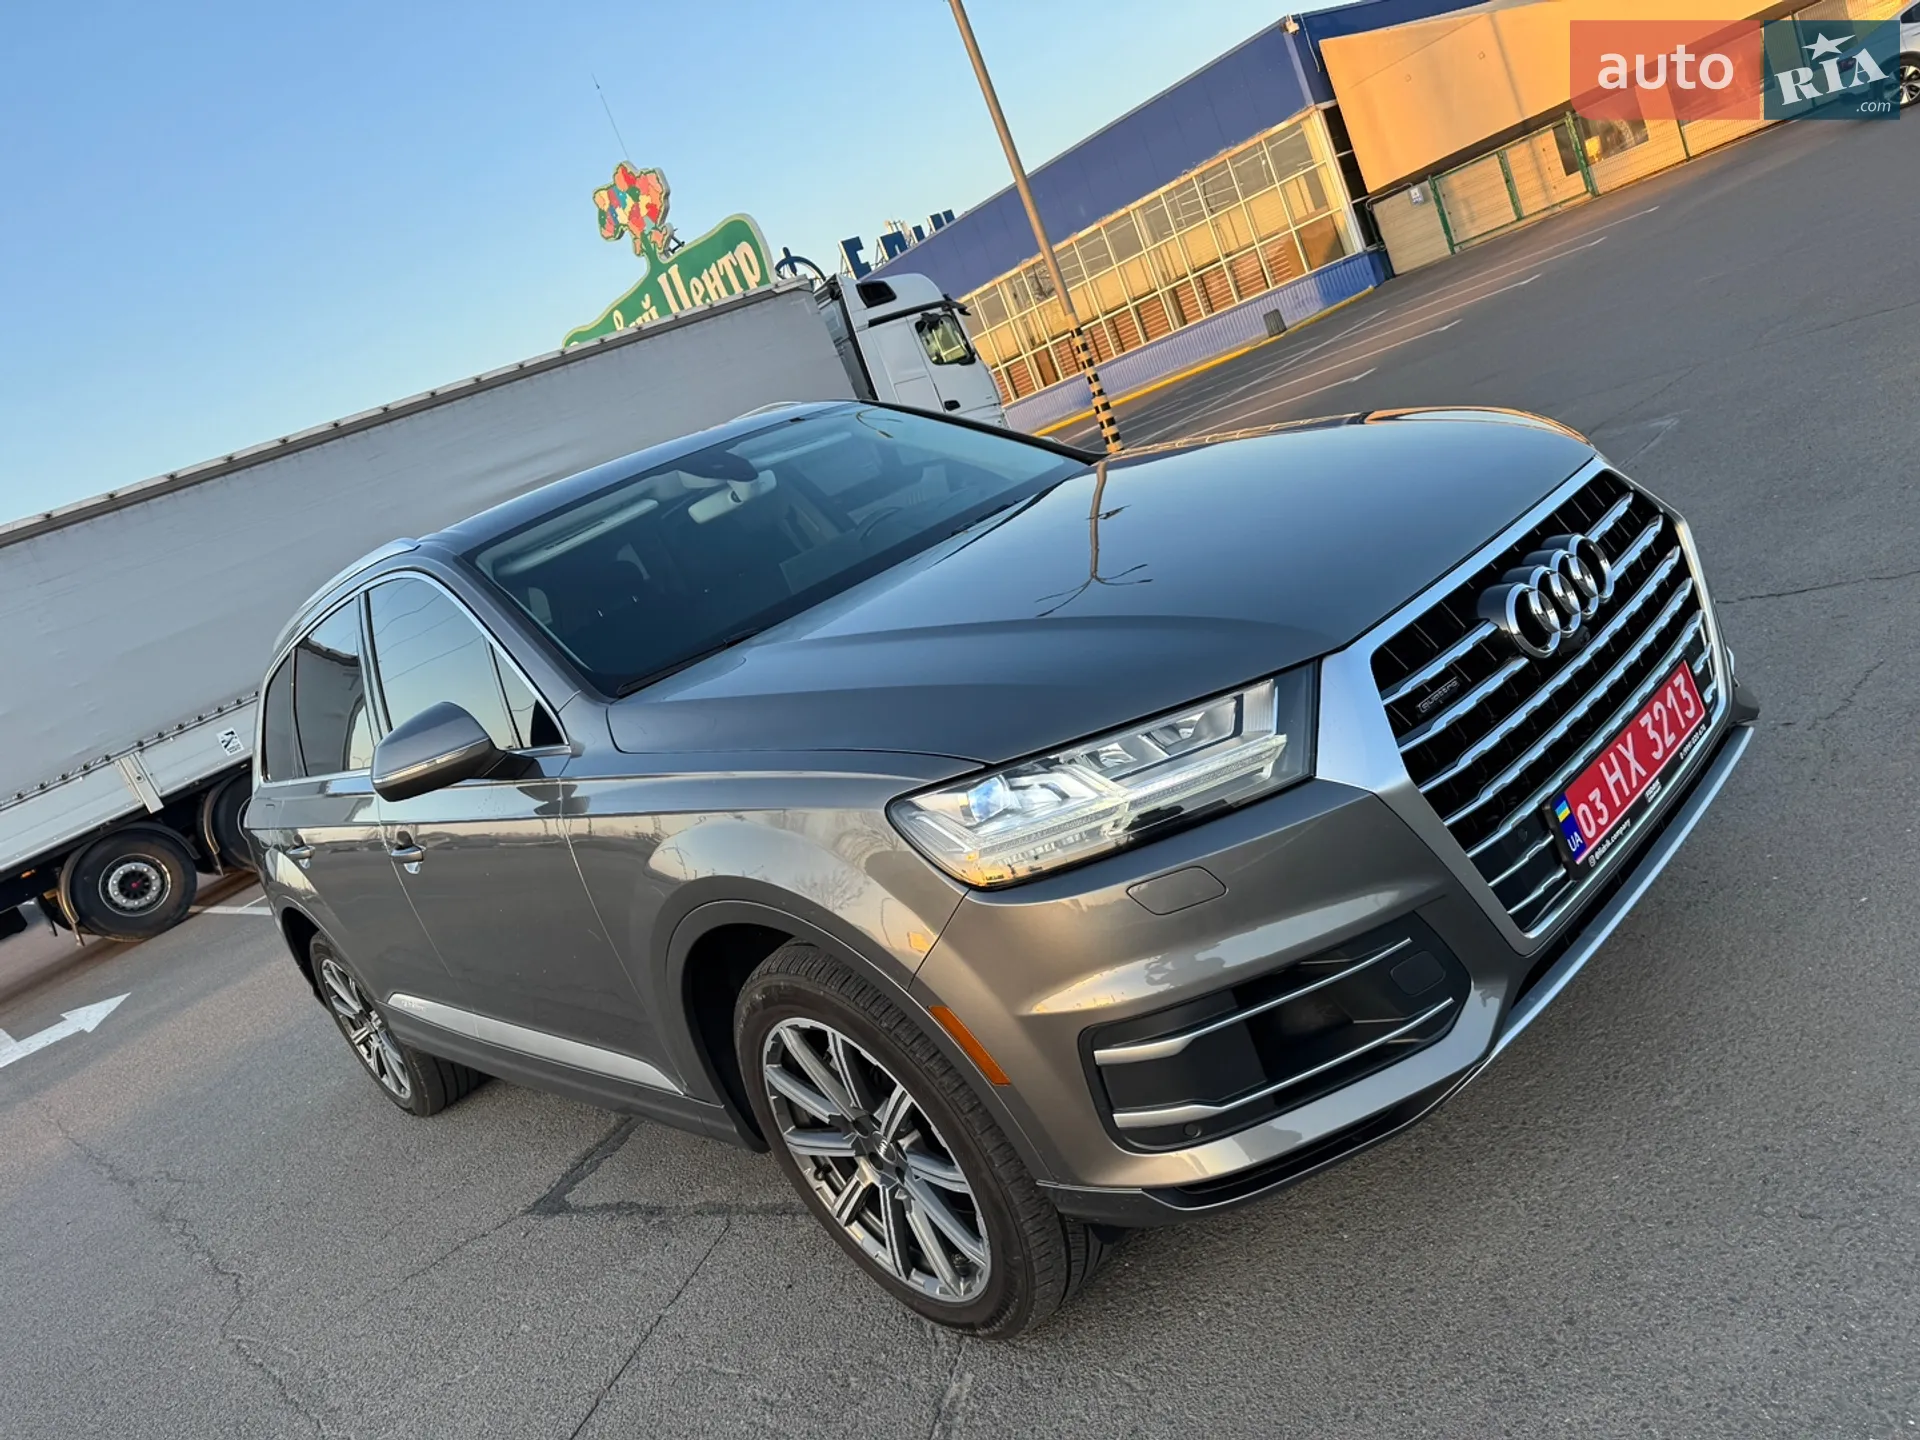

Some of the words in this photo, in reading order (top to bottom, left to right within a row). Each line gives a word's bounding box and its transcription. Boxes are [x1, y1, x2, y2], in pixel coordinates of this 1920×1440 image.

[657, 241, 761, 314] Центр
[1577, 788, 1609, 839] 03
[1599, 732, 1646, 808] HX
[1639, 673, 1695, 760] 3213
[1567, 831, 1584, 852] UA
